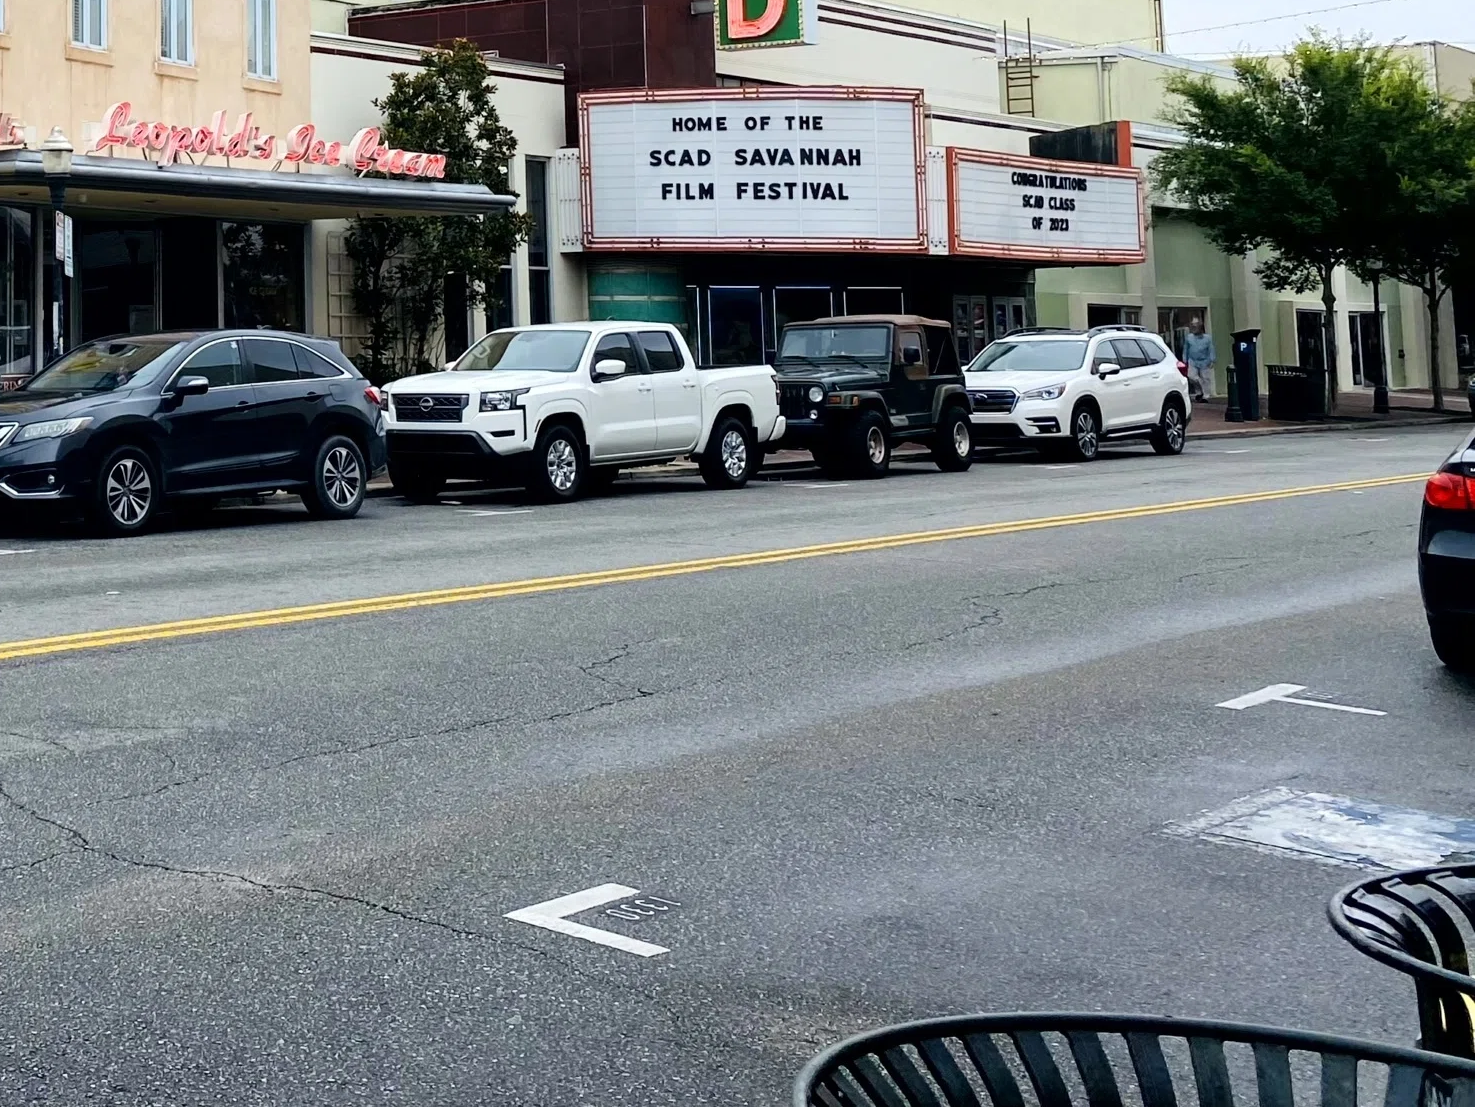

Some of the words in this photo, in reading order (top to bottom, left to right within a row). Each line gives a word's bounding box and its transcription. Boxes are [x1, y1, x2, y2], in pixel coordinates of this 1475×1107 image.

[672, 116, 727, 132] HOME
[744, 116, 771, 131] OF
[785, 115, 823, 131] THE
[96, 101, 276, 168] Leopold's
[284, 123, 341, 167] Ice
[346, 127, 447, 179] Cream
[649, 149, 711, 167] SCAD
[734, 148, 862, 167] SAVANNAH
[1011, 171, 1087, 192] CONGRATULATIONS
[661, 183, 714, 200] FILM
[736, 182, 849, 200] FESTIVAL
[1022, 194, 1044, 209] SCAD
[1048, 196, 1076, 211] CLASS
[1032, 216, 1044, 230] OF
[1049, 217, 1070, 232] 2023
[1240, 342, 1248, 352] P
